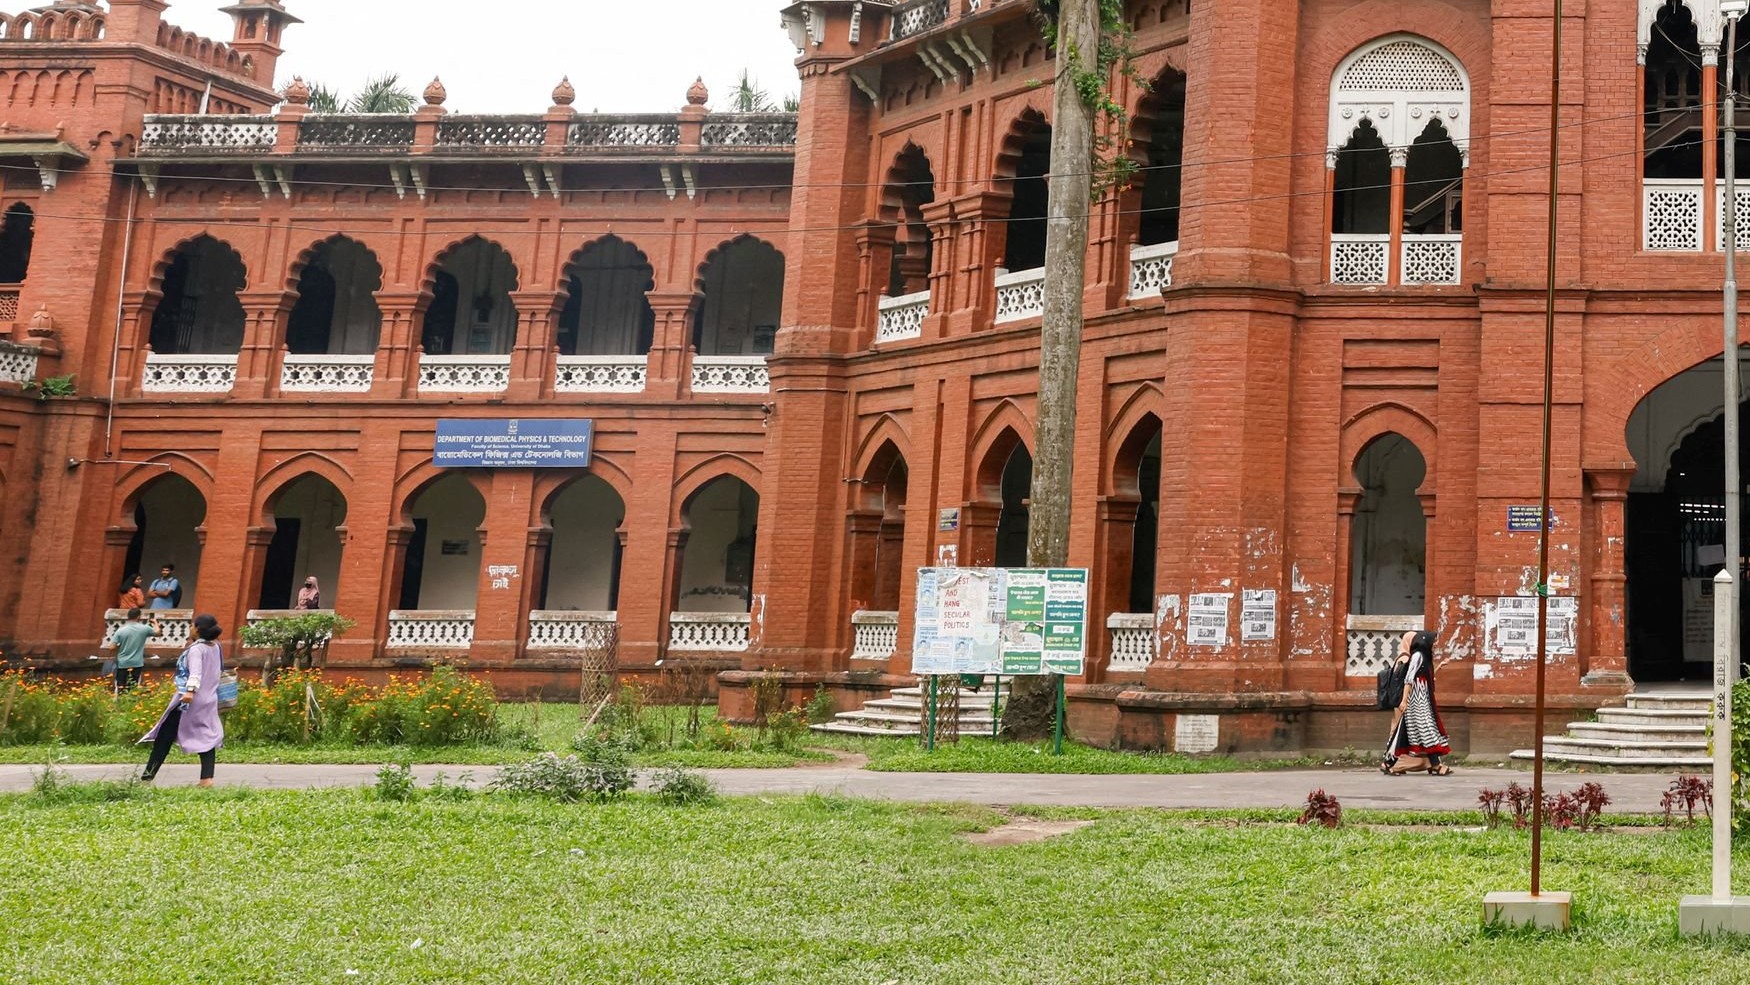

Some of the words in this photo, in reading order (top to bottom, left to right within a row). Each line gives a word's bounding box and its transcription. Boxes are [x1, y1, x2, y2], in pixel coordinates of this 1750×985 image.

[437, 435, 474, 443] DEPARTMENT
[475, 435, 484, 443] OF
[484, 435, 518, 443] BIOMEDICAL
[518, 435, 542, 443] PHYSICS
[543, 435, 547, 443] &
[549, 435, 586, 443] TECHNOLOGY
[945, 589, 958, 597] AND
[943, 600, 960, 608] HANG
[943, 621, 970, 629] POLITICS
